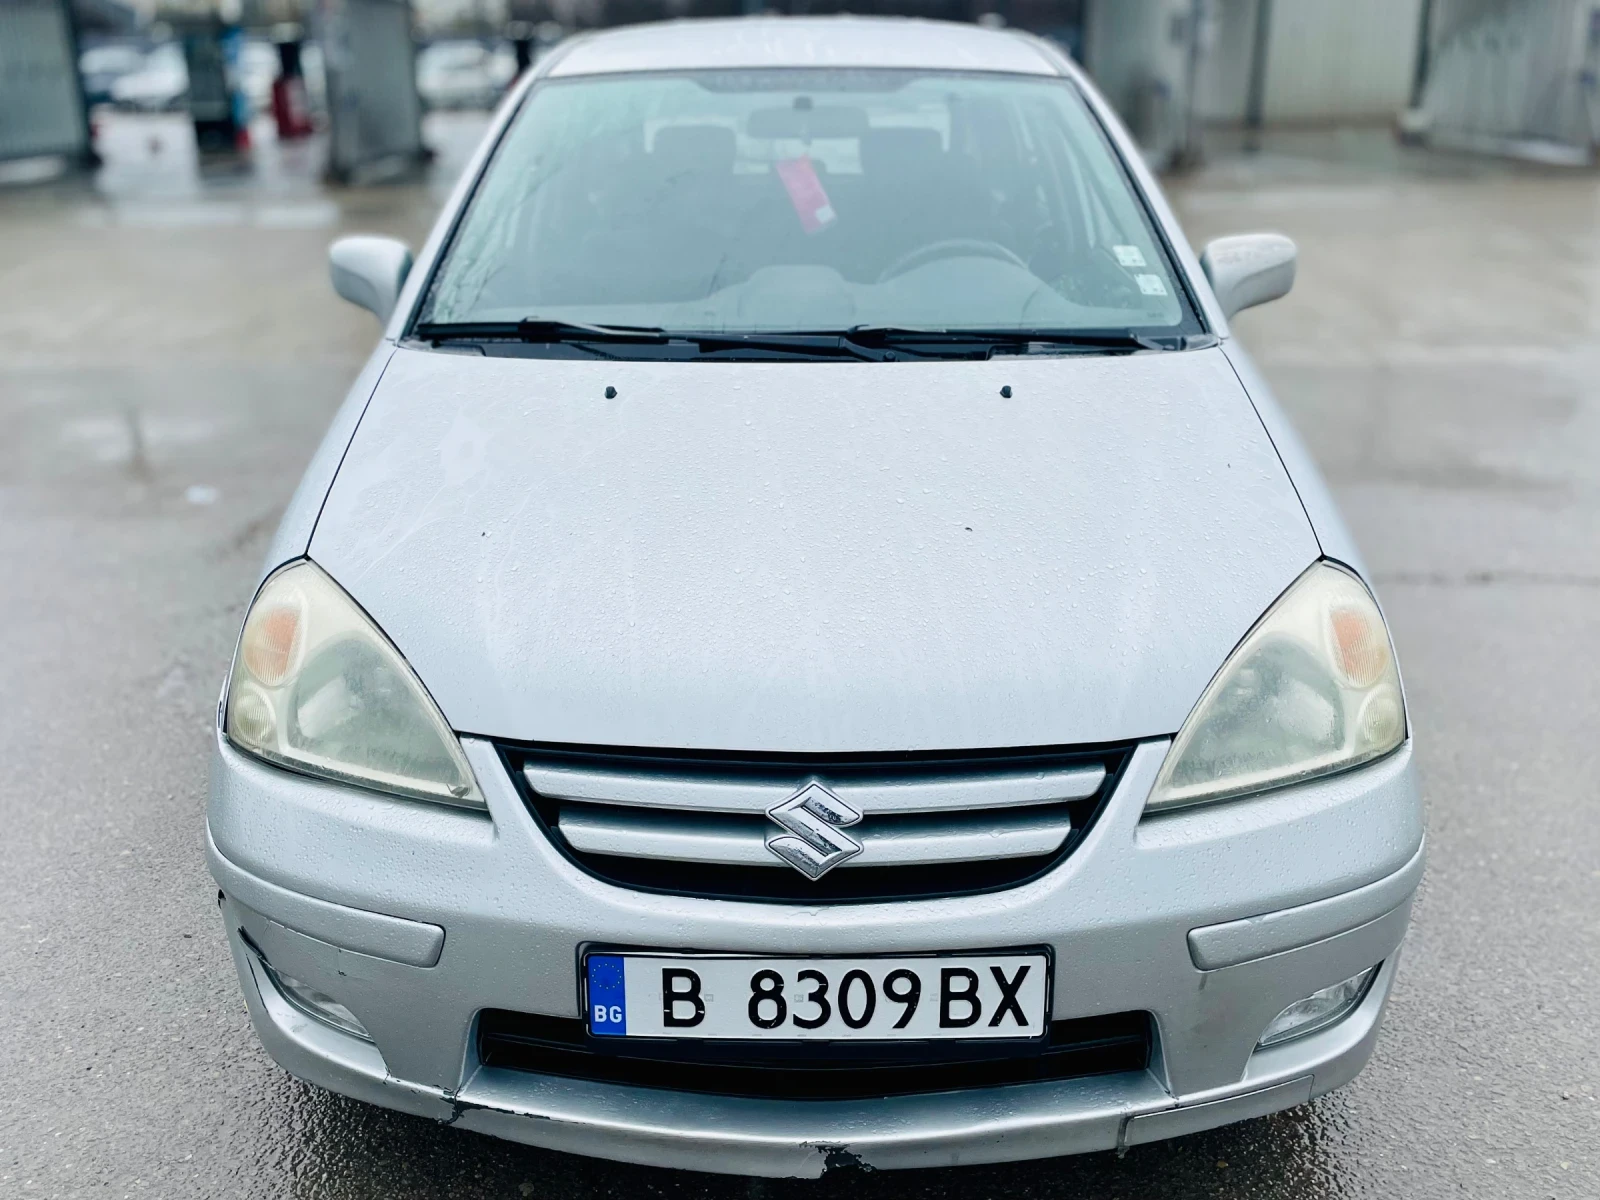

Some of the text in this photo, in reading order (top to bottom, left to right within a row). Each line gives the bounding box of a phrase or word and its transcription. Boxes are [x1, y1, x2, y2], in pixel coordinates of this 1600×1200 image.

[594, 1005, 622, 1023] BG
[661, 967, 706, 1028] B
[747, 968, 922, 1030] 8309
